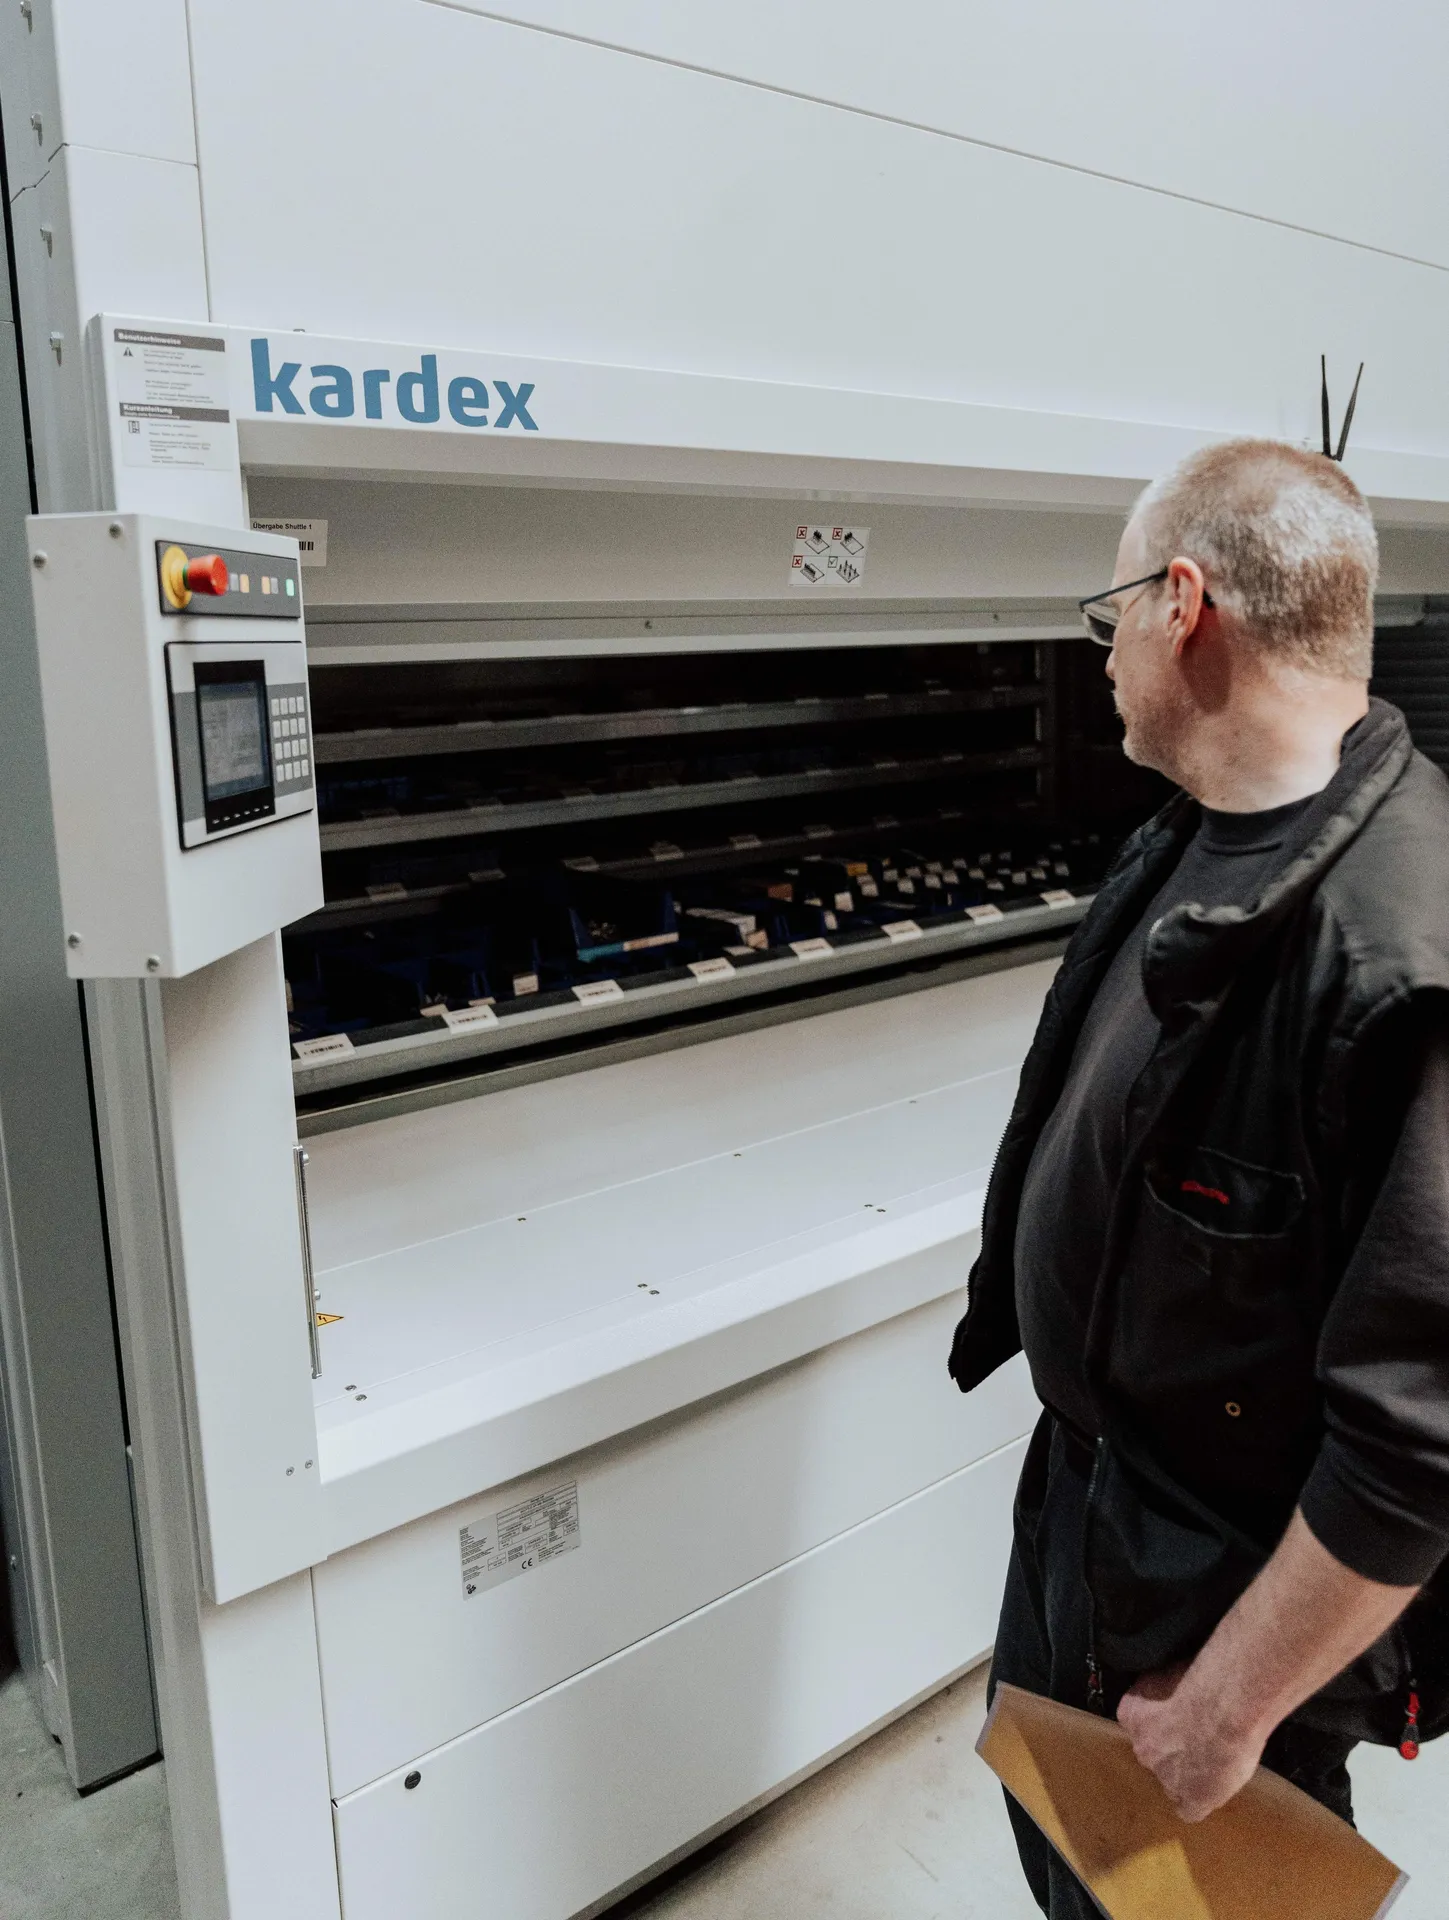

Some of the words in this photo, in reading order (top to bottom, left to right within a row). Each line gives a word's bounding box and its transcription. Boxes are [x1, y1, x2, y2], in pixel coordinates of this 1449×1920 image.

[118, 333, 182, 345] Benutzerhinweise
[250, 338, 538, 431] kardex
[123, 404, 173, 415] Kurzanleitung
[252, 521, 284, 531] Übergabe
[521, 1557, 533, 1570] CE
